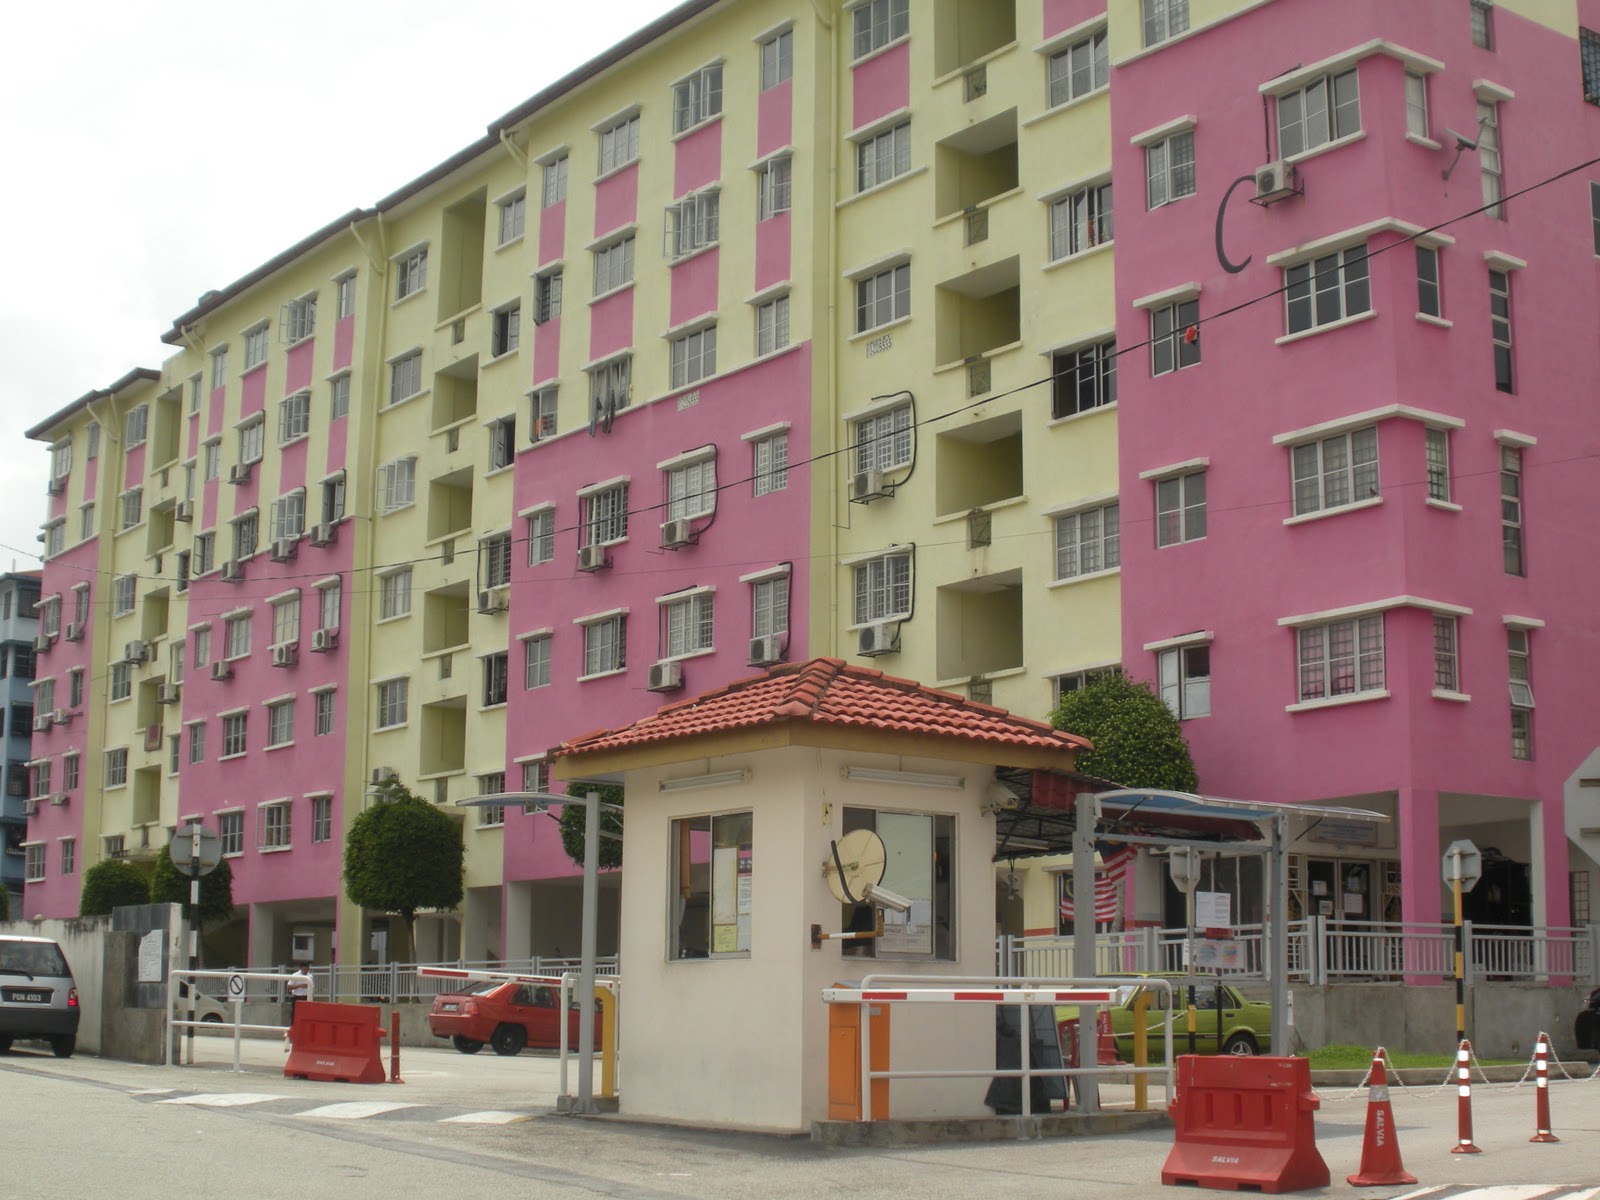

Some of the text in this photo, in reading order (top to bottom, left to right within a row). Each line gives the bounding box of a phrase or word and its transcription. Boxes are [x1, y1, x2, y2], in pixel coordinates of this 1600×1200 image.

[12, 993, 25, 1001] PGN
[1376, 1109, 1385, 1147] SALVIA
[1212, 1155, 1238, 1163] SALVIA
